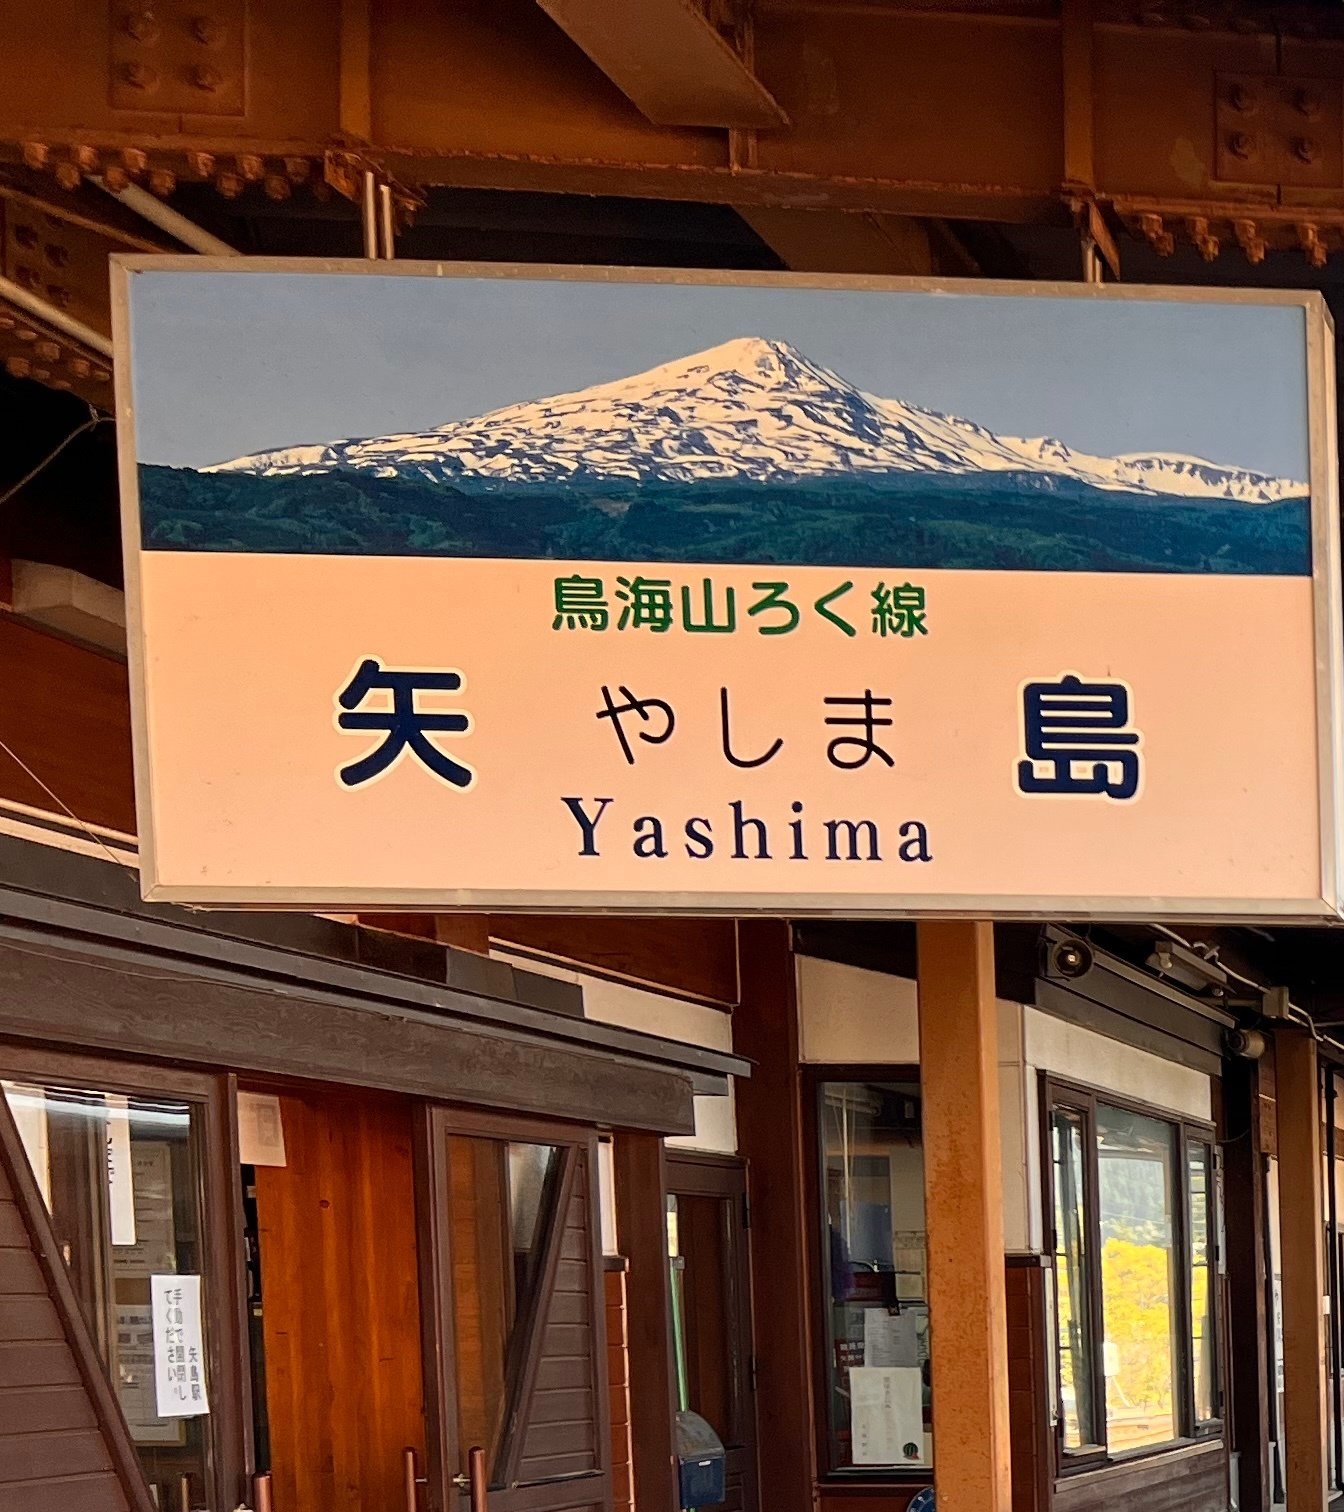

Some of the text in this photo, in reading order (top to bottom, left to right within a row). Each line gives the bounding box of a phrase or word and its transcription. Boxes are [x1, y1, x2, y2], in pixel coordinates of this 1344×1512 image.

[552, 574, 929, 637] 鳥海山ろく線
[338, 659, 1143, 797] 矢 やしま 島
[561, 796, 934, 863] Yashima
